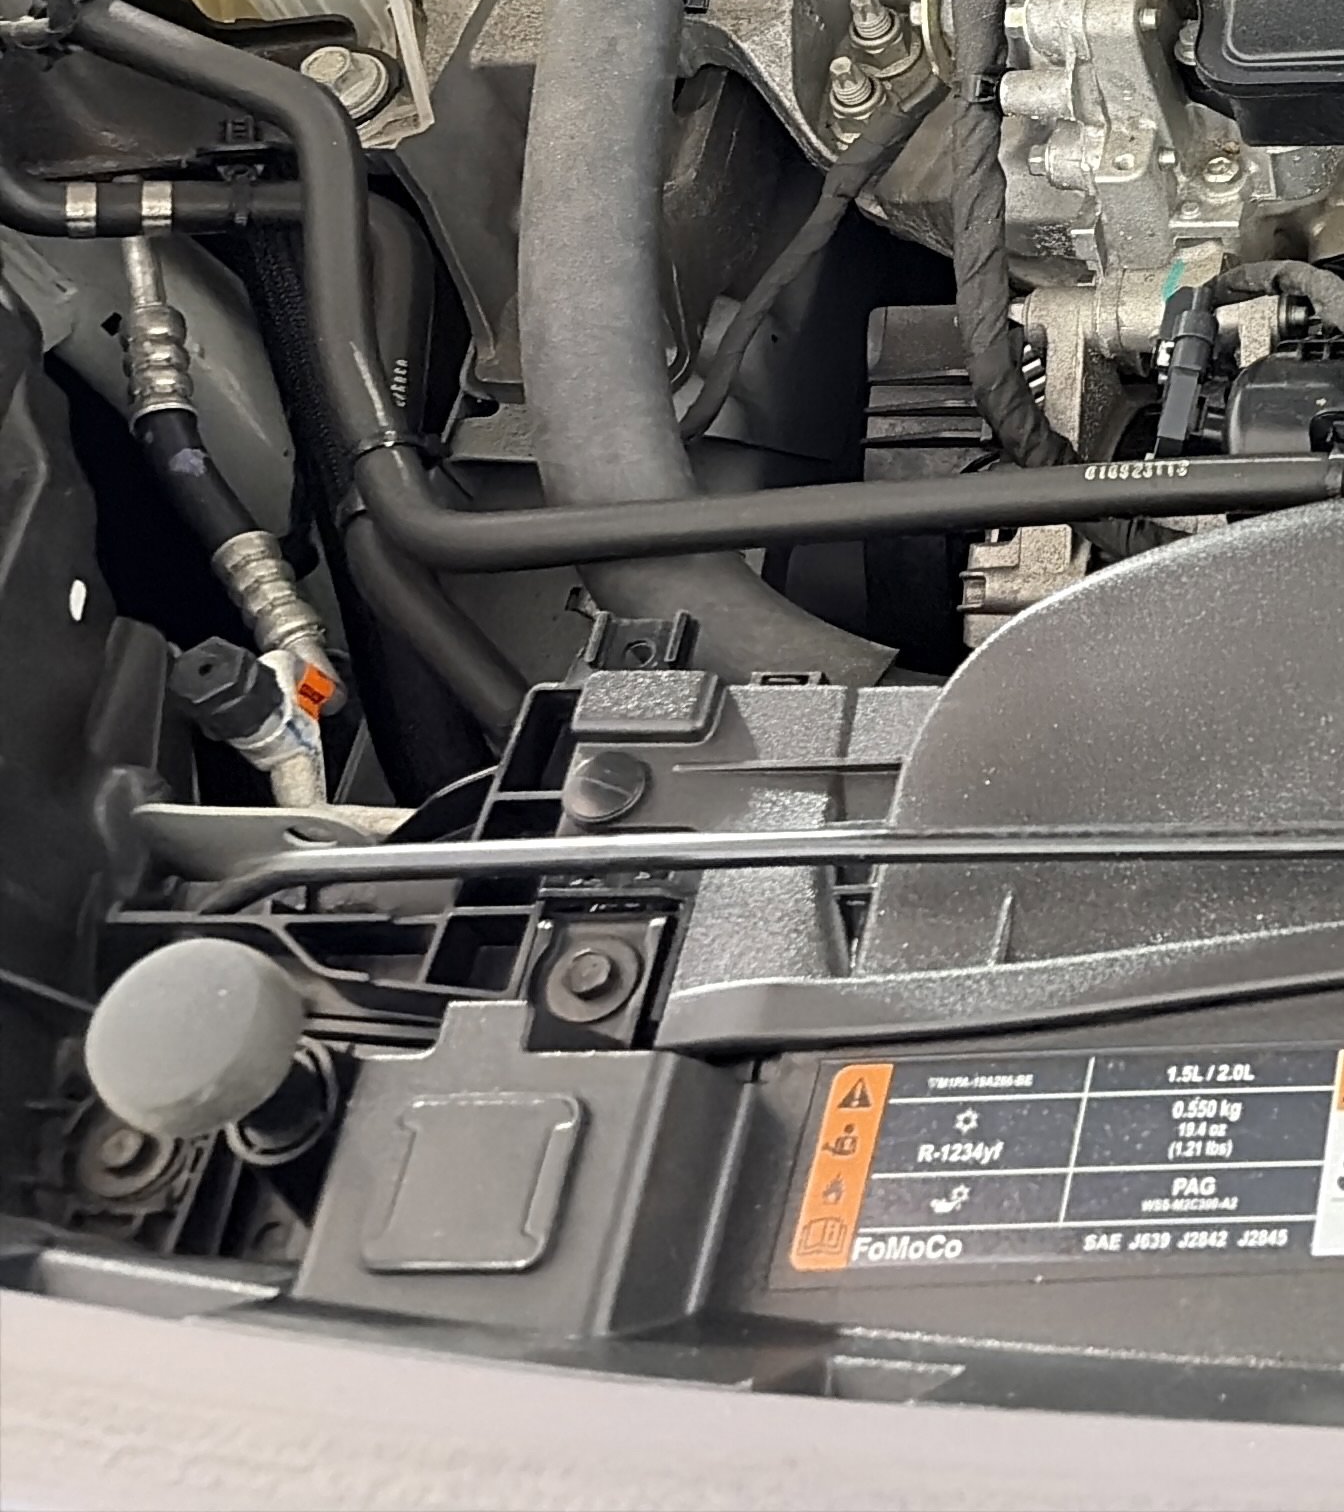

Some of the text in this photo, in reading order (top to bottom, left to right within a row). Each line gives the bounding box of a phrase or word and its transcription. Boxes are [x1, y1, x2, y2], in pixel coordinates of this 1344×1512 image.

[1167, 1063, 1255, 1083] 1.5L / 2.0L
[1172, 1099, 1243, 1122] 0.550 kg
[1178, 1122, 1228, 1137] 19.4 oz
[917, 1141, 1005, 1165] R-1234yf
[1167, 1139, 1234, 1161] (1.21 lbs)
[1171, 1176, 1216, 1196] PAG
[850, 1234, 963, 1261] FoMoCo
[1083, 1228, 1289, 1252] SAE J639 J2842 J2845
